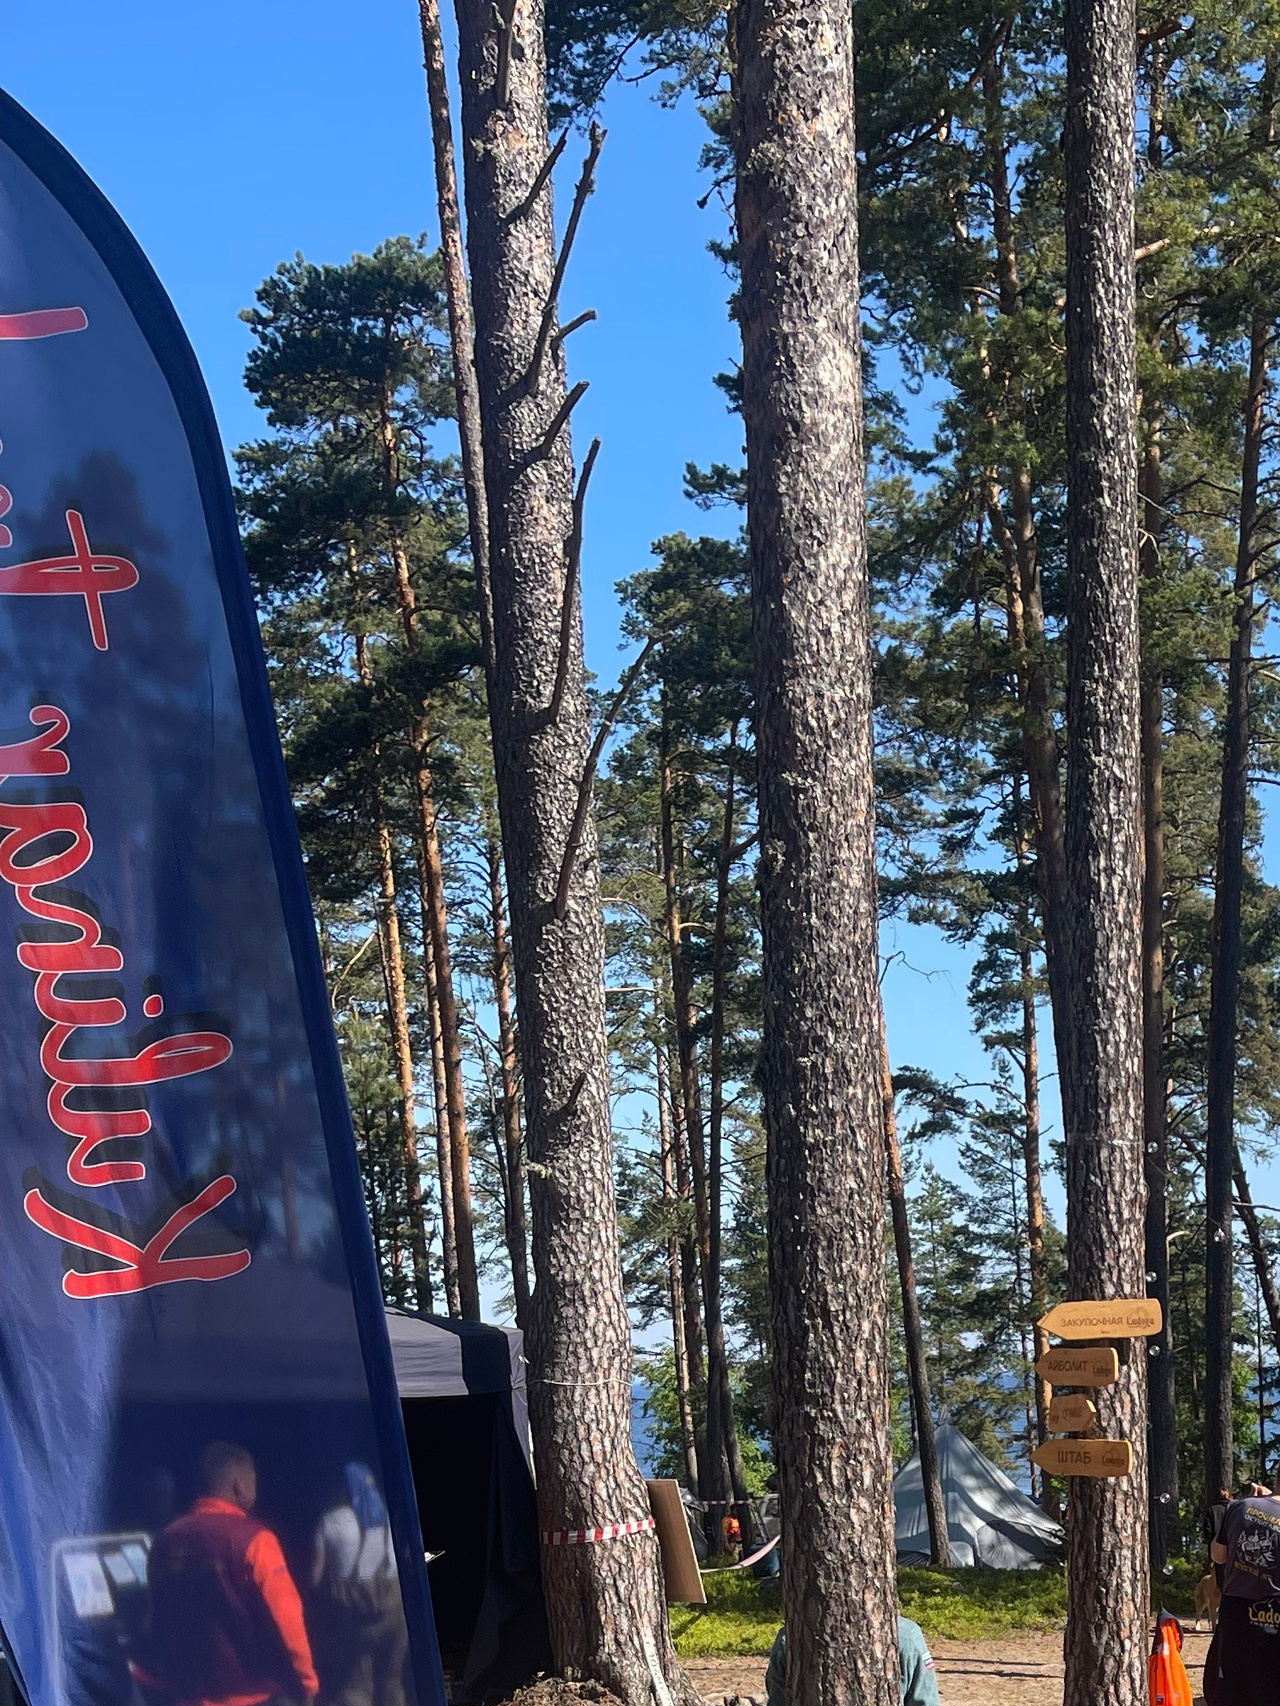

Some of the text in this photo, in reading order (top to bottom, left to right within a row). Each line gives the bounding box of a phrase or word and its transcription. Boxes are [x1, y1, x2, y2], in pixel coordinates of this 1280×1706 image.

[1060, 1317, 1123, 1328] ЗАКУПОЧНАЯ
[1047, 1360, 1088, 1372] АЙБОЛИТ
[1057, 1451, 1092, 1464] ШТАБ
